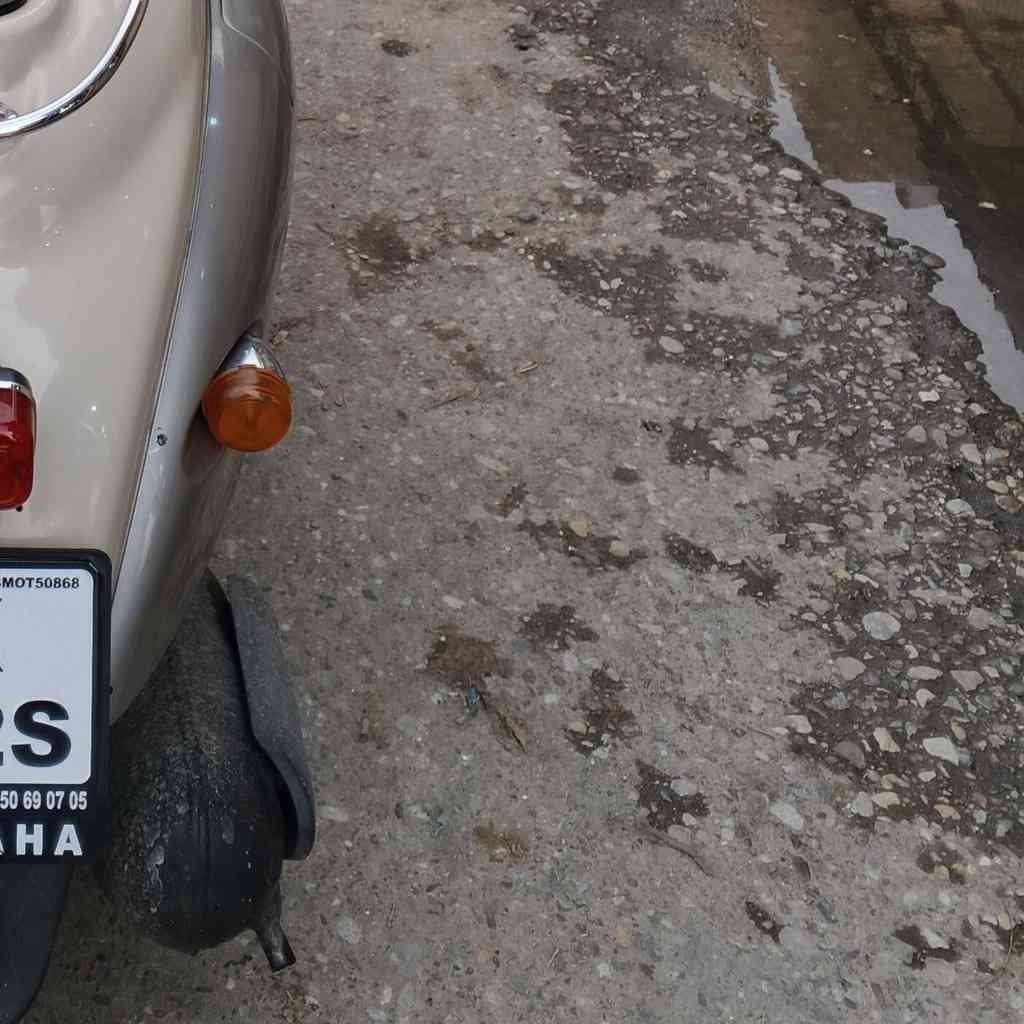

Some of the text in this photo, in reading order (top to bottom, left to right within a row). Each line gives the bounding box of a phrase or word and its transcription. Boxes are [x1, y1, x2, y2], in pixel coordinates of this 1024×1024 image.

[0, 790, 19, 810] 50
[23, 790, 42, 810] 69
[46, 790, 65, 810] 07
[69, 790, 88, 810] 05
